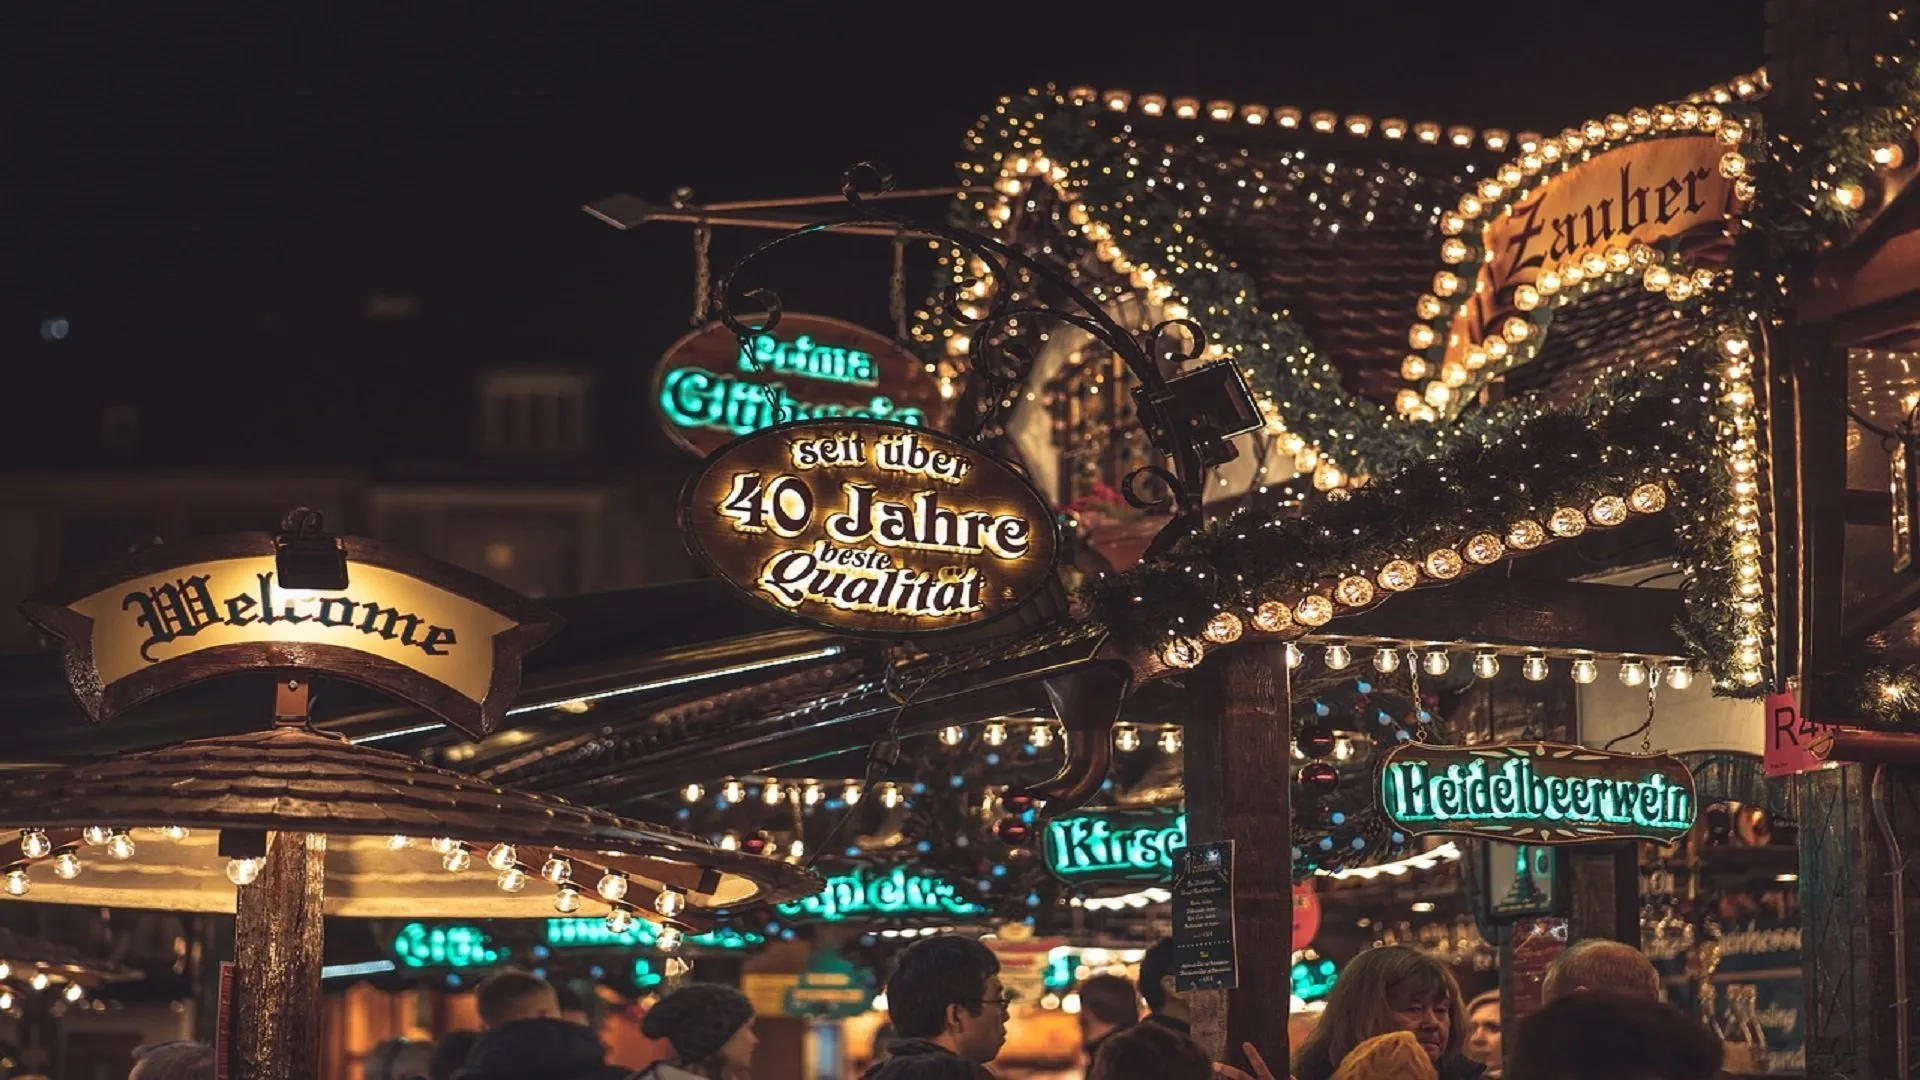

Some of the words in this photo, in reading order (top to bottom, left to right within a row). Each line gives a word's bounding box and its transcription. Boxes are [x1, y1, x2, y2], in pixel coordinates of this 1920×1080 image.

[1506, 161, 1711, 281] Zauber
[738, 333, 880, 388] Prima
[796, 434, 867, 468] seit
[877, 434, 973, 483] über
[717, 473, 814, 537] 40
[826, 483, 1031, 557] Jahre
[817, 540, 892, 570] beste
[122, 571, 457, 662] Welcome
[1391, 757, 1692, 828] Heidelbeerwein
[1051, 815, 1188, 874] Kirsc
